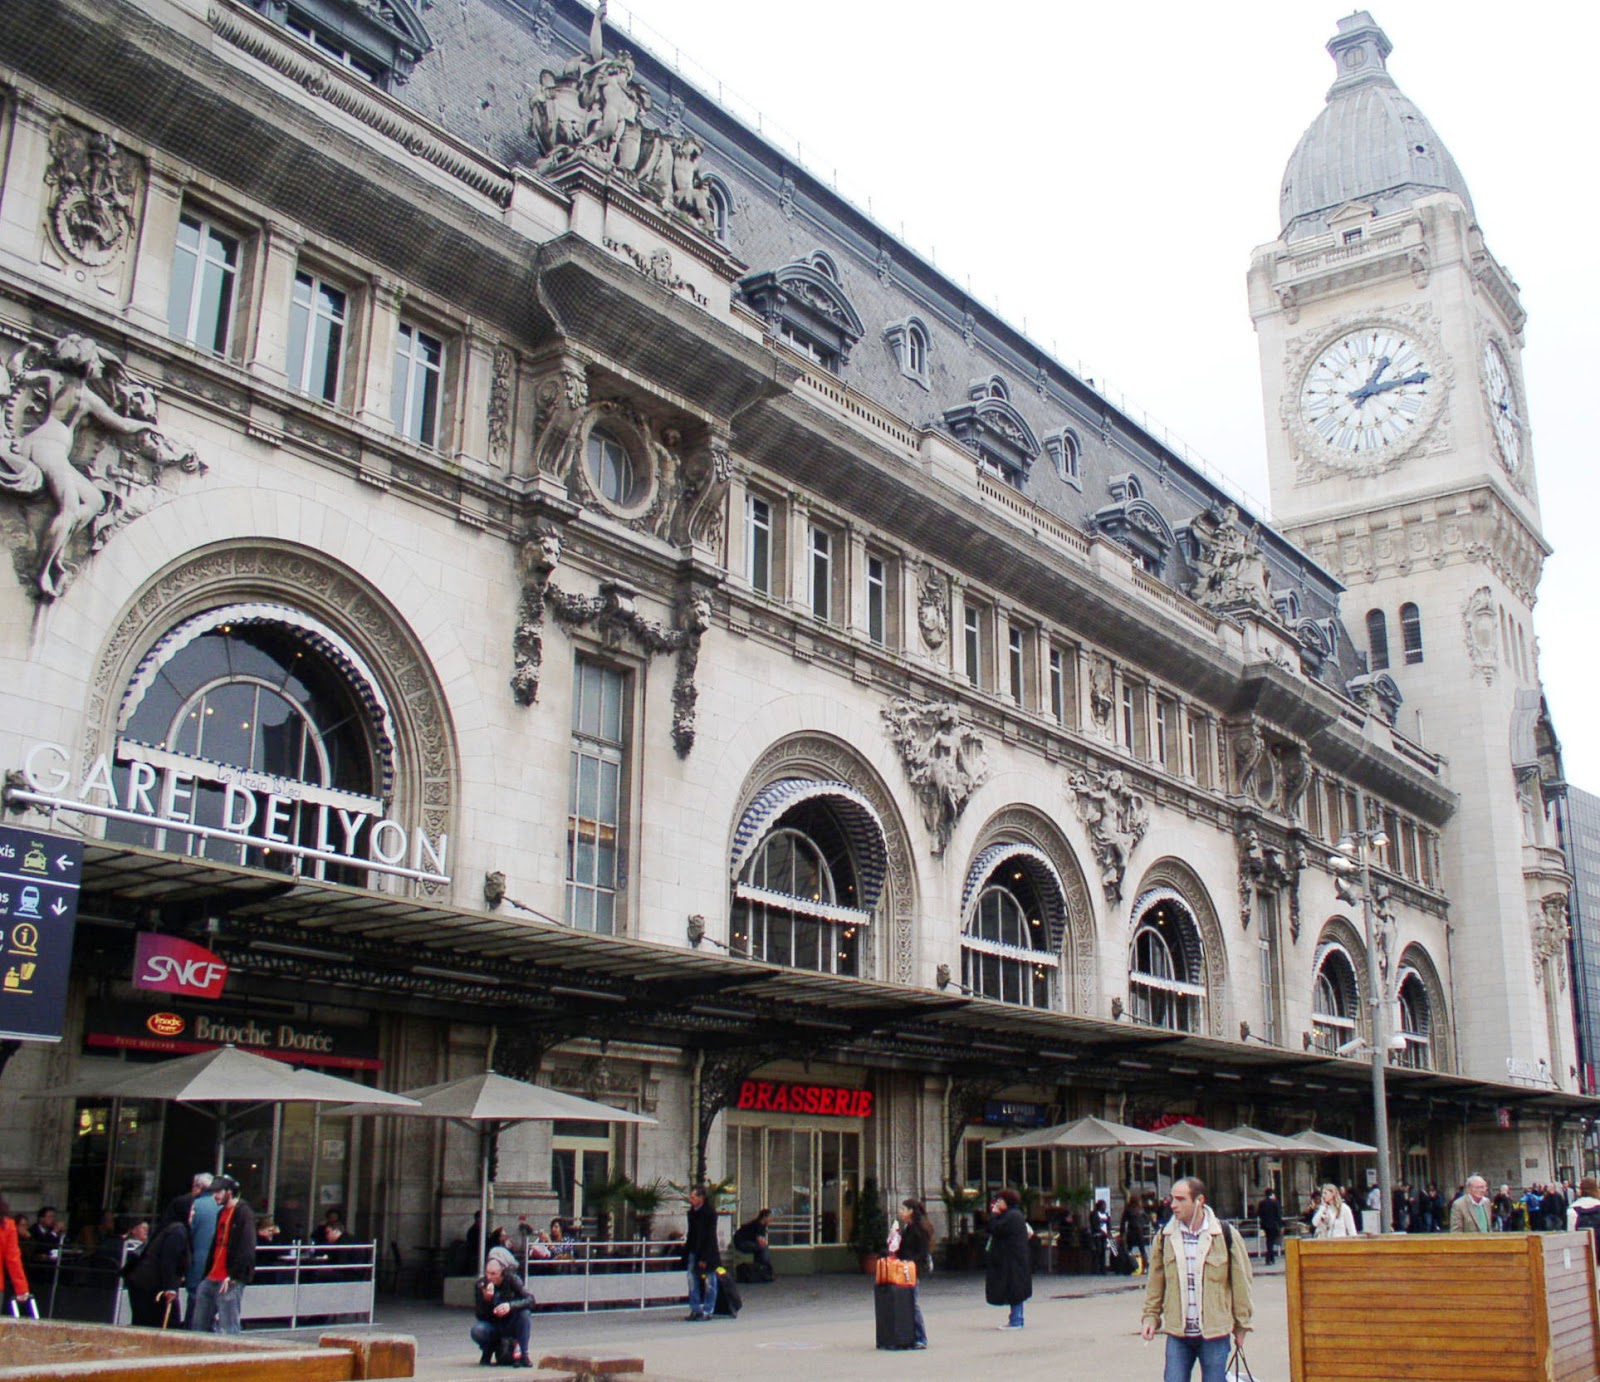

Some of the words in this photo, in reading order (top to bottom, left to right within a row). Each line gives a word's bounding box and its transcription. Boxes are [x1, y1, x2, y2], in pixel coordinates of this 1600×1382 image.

[24, 742, 194, 820] GARE
[223, 783, 292, 842] DE
[317, 804, 448, 876] LYON
[142, 955, 227, 988] SNCF
[195, 1015, 272, 1046] Brioche
[277, 1024, 333, 1051] Dorée
[737, 1081, 874, 1117] BRASSERIE
